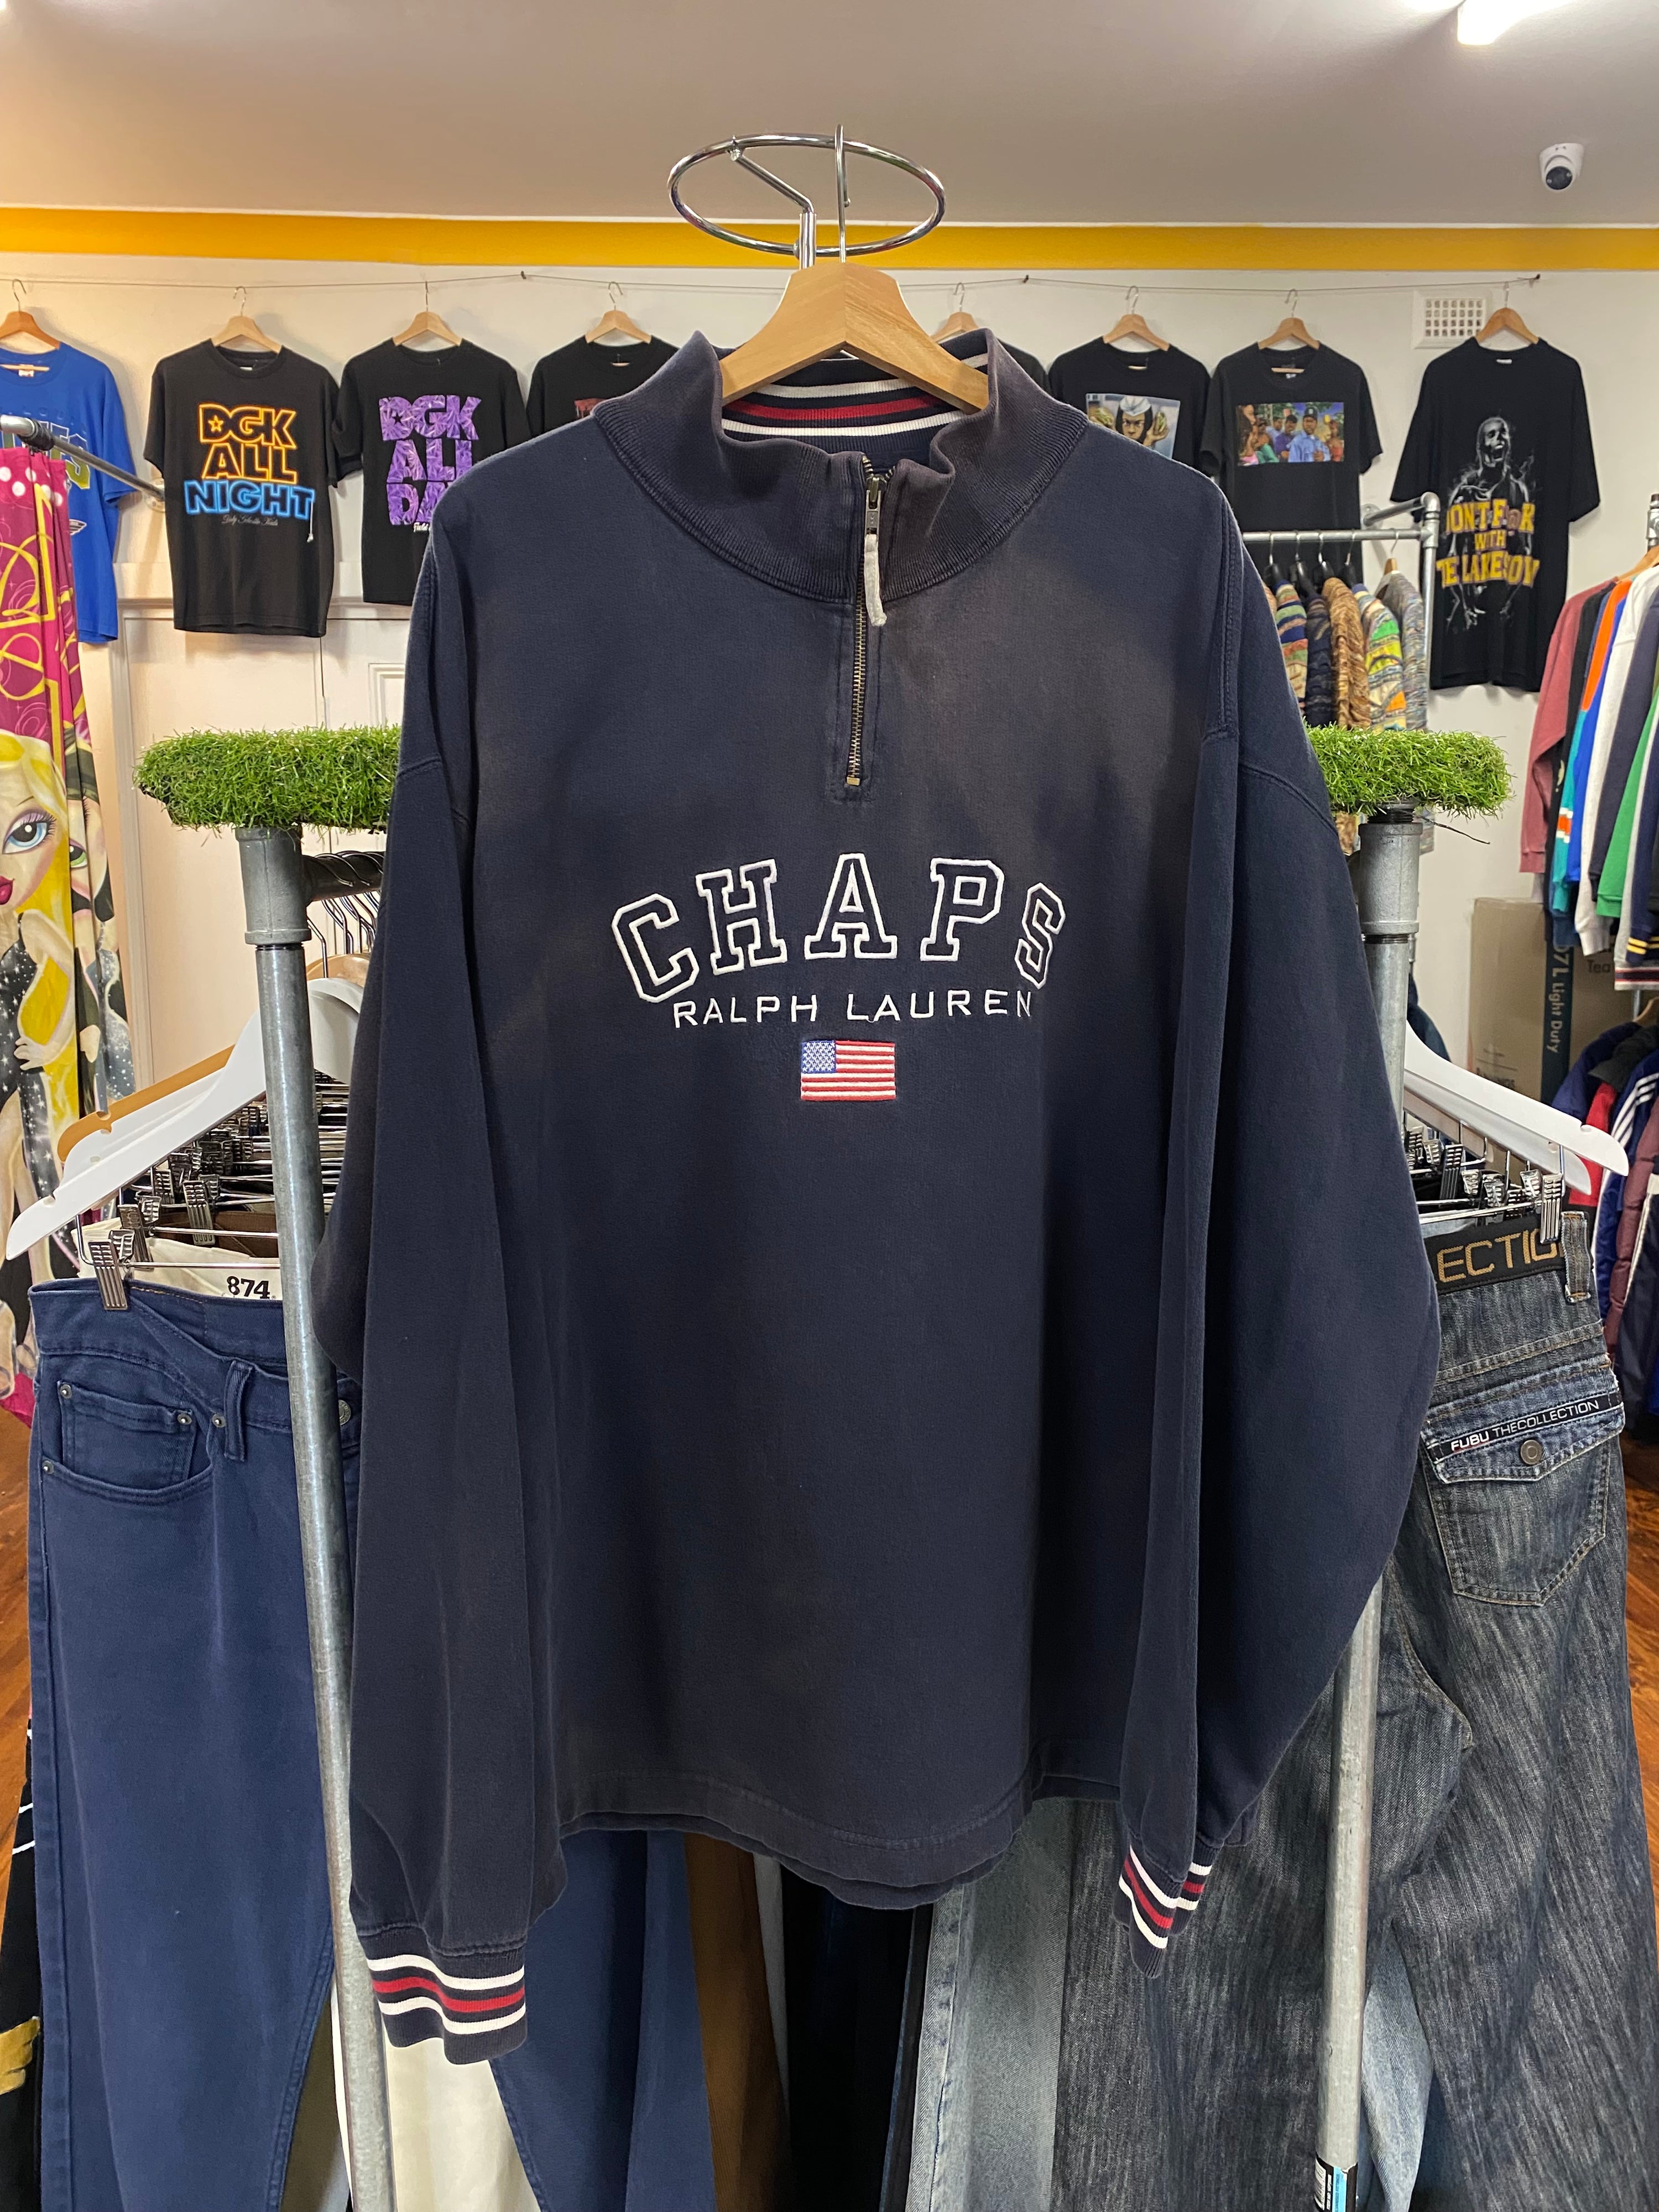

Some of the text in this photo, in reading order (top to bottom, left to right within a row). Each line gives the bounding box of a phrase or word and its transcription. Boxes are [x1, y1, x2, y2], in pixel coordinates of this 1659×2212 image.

[198, 403, 298, 450] DGK
[379, 395, 482, 441] DGK
[201, 442, 298, 484] ALL
[184, 479, 316, 521] NIGHT
[386, 481, 453, 525] DA
[611, 852, 1067, 1003] CHAPS
[674, 989, 1033, 1029] RALPH LAUREN
[1549, 982, 1565, 1016] Light
[1547, 1020, 1563, 1053] Duty
[1437, 1228, 1564, 1283] ECTIO
[226, 1275, 270, 1299] 874
[1451, 1431, 1490, 1452] FUBU
